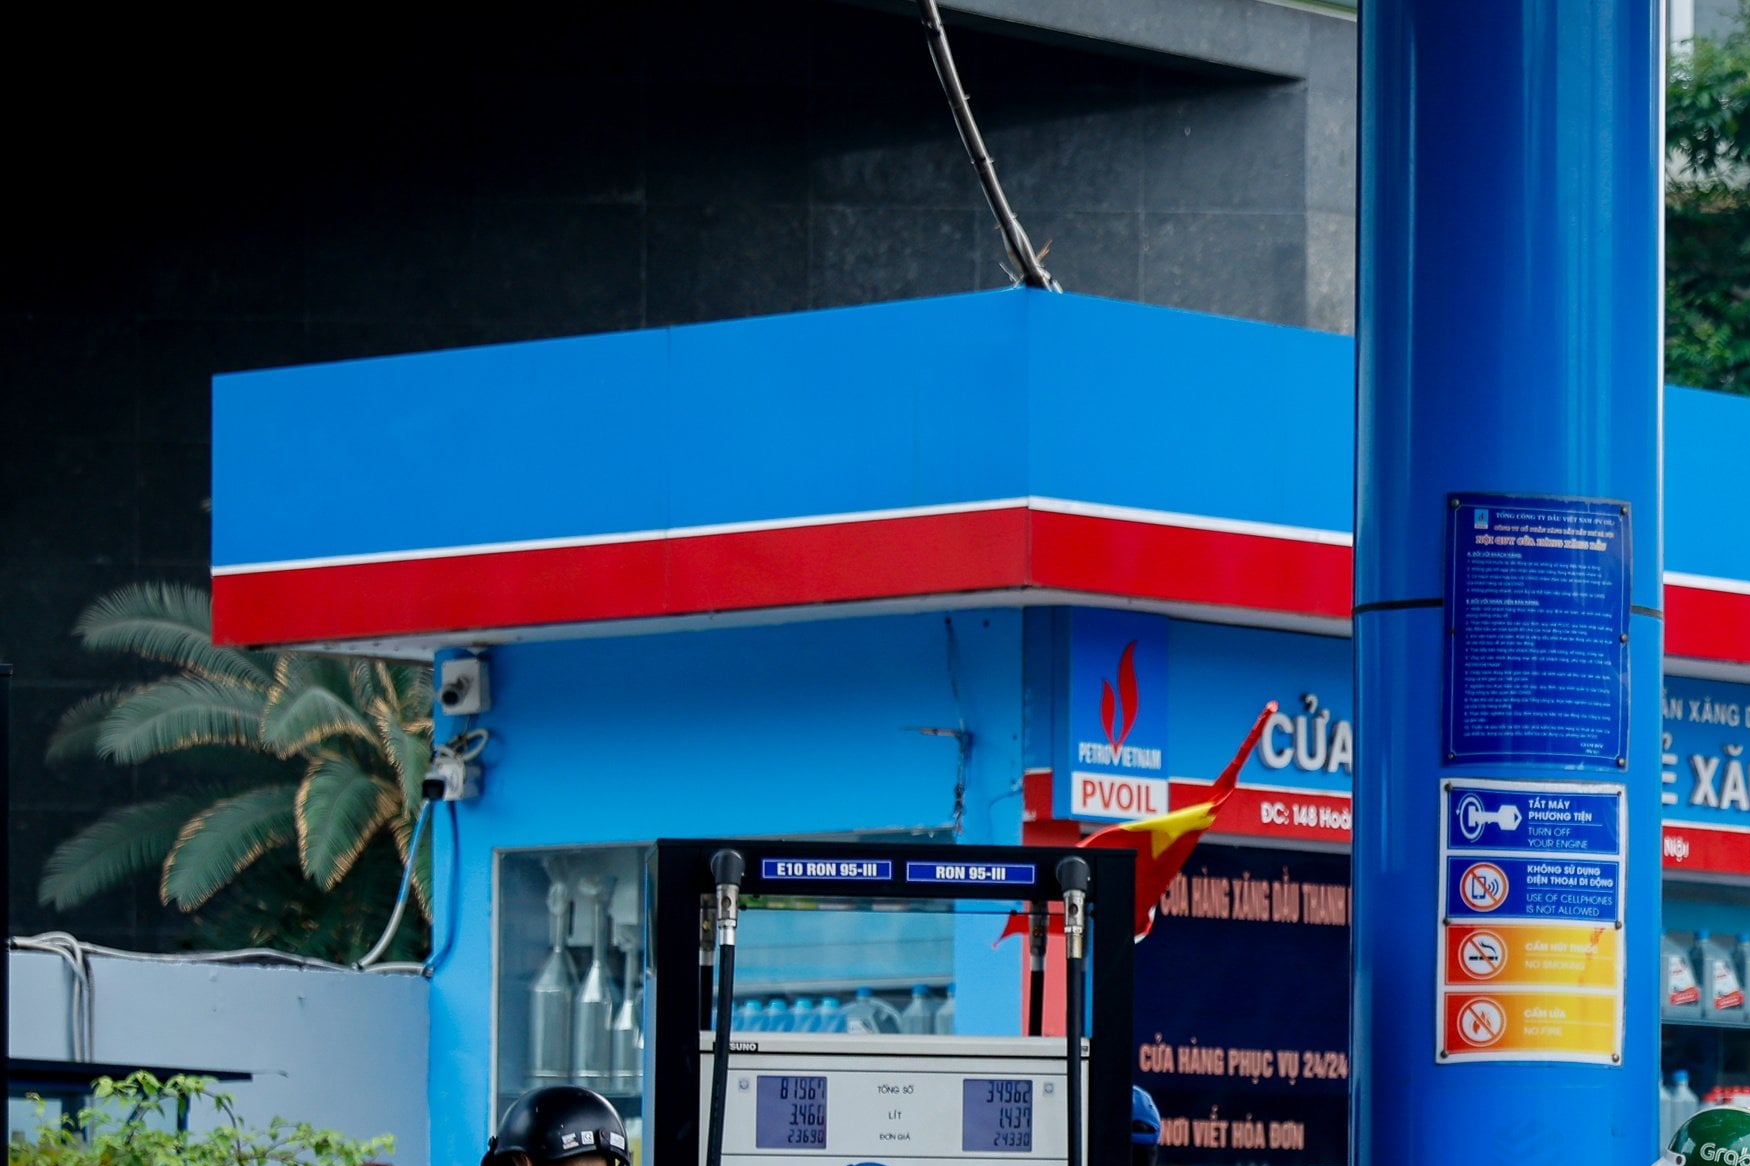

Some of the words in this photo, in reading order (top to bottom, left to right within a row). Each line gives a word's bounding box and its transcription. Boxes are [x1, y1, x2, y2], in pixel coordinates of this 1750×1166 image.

[1689, 698, 1740, 726] XĂNG
[1079, 742, 1161, 769] PETROVIETNAM
[1082, 779, 1157, 814] PVOIL
[1548, 798, 1571, 810] MÁY
[1293, 804, 1317, 827] 148
[1319, 807, 1352, 831] Hoà
[1528, 811, 1571, 822] PHƯƠNG
[1573, 811, 1592, 823] TIỆN
[1528, 827, 1552, 836] TURN
[1554, 828, 1571, 837] OFF
[1528, 838, 1554, 848] YOUR
[1556, 840, 1588, 849] ENGINE
[777, 862, 802, 876] E10
[807, 863, 836, 876] RON
[840, 864, 877, 877] 95-III
[936, 866, 965, 880] RON
[969, 866, 1006, 880] 95-III
[1527, 864, 1562, 875] KHÔNG
[1564, 864, 1576, 875] SỬ
[1577, 866, 1601, 877] DỤNG
[1527, 875, 1548, 886] ĐIỆN
[1550, 877, 1577, 887] THOẠI
[1579, 878, 1589, 887] DI
[1527, 893, 1544, 902] USE
[1545, 894, 1558, 903] OF
[1560, 895, 1612, 905] CELLPHONES
[1526, 905, 1534, 913] IS
[1535, 906, 1556, 914] NOT
[1558, 906, 1599, 917] ALLOWED
[1524, 1027, 1539, 1036] NO
[729, 1043, 757, 1052] SUNO
[1139, 1032, 1175, 1074] CỬA
[1178, 1037, 1225, 1076] HÀNG
[1228, 1048, 1273, 1086] PHỤC
[1277, 1050, 1300, 1086] VỤ
[1303, 1051, 1349, 1080] 24/24
[889, 1109, 902, 1120] LÍT
[1231, 1112, 1266, 1150] HÓA
[1269, 1120, 1305, 1151] ĐƠN
